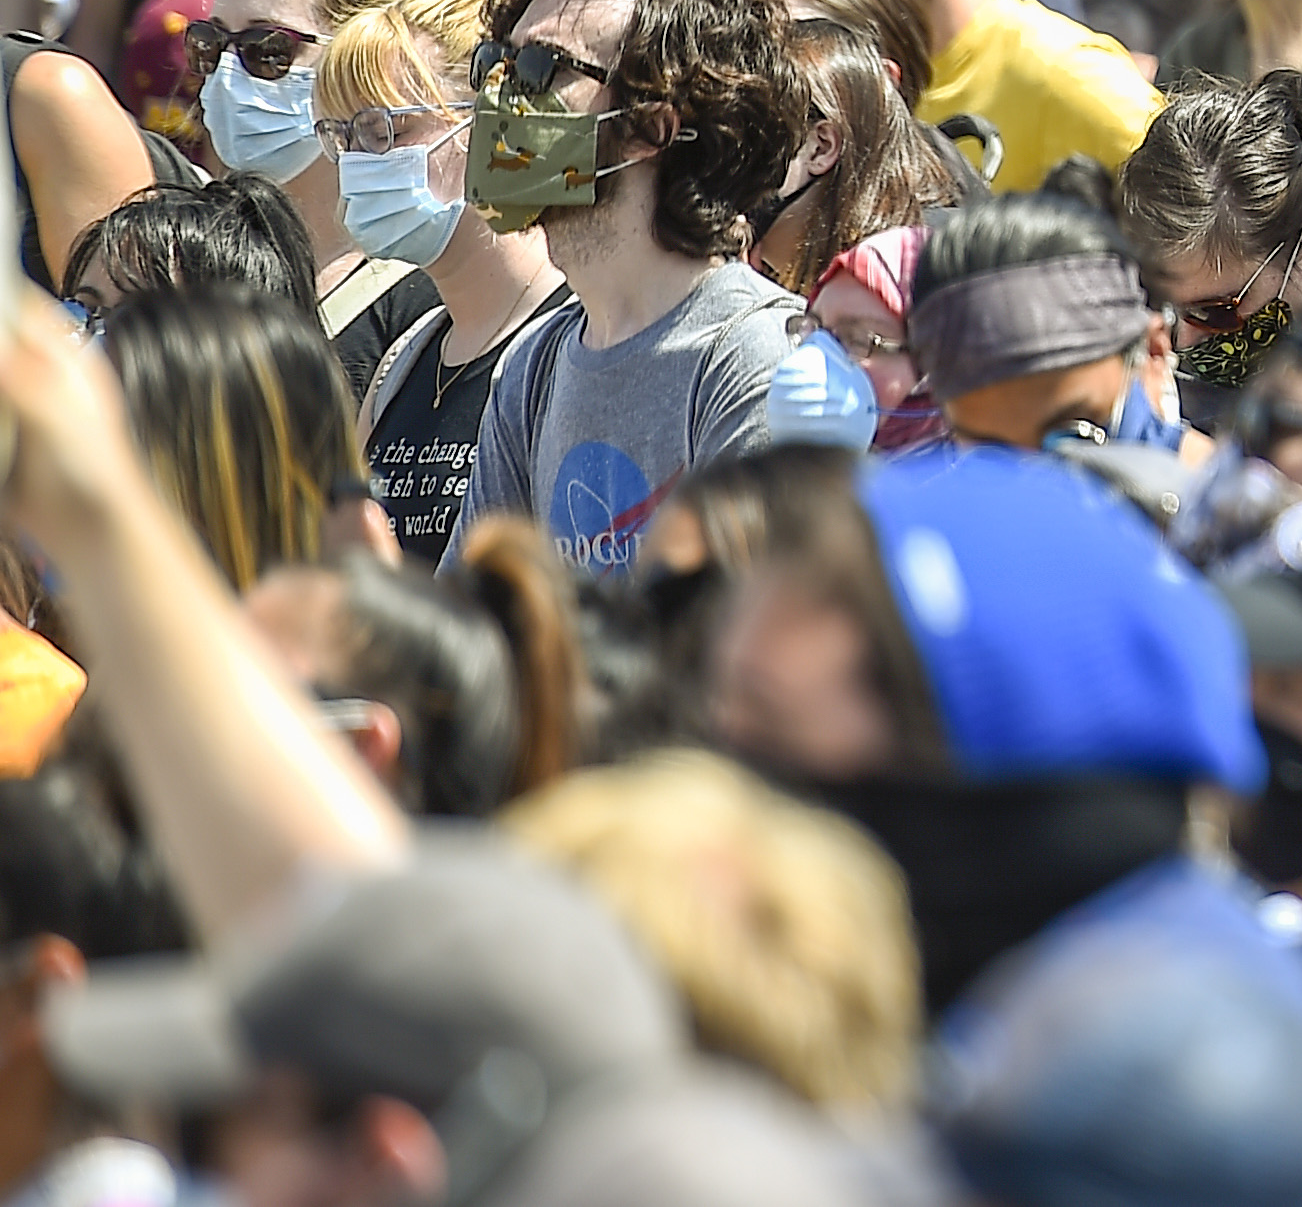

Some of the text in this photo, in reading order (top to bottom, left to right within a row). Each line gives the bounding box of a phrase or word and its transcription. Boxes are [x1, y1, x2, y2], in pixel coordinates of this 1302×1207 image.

[382, 437, 416, 464] the
[417, 437, 479, 469] change
[419, 473, 437, 496] to
[441, 474, 470, 496] se
[404, 505, 451, 536] world
